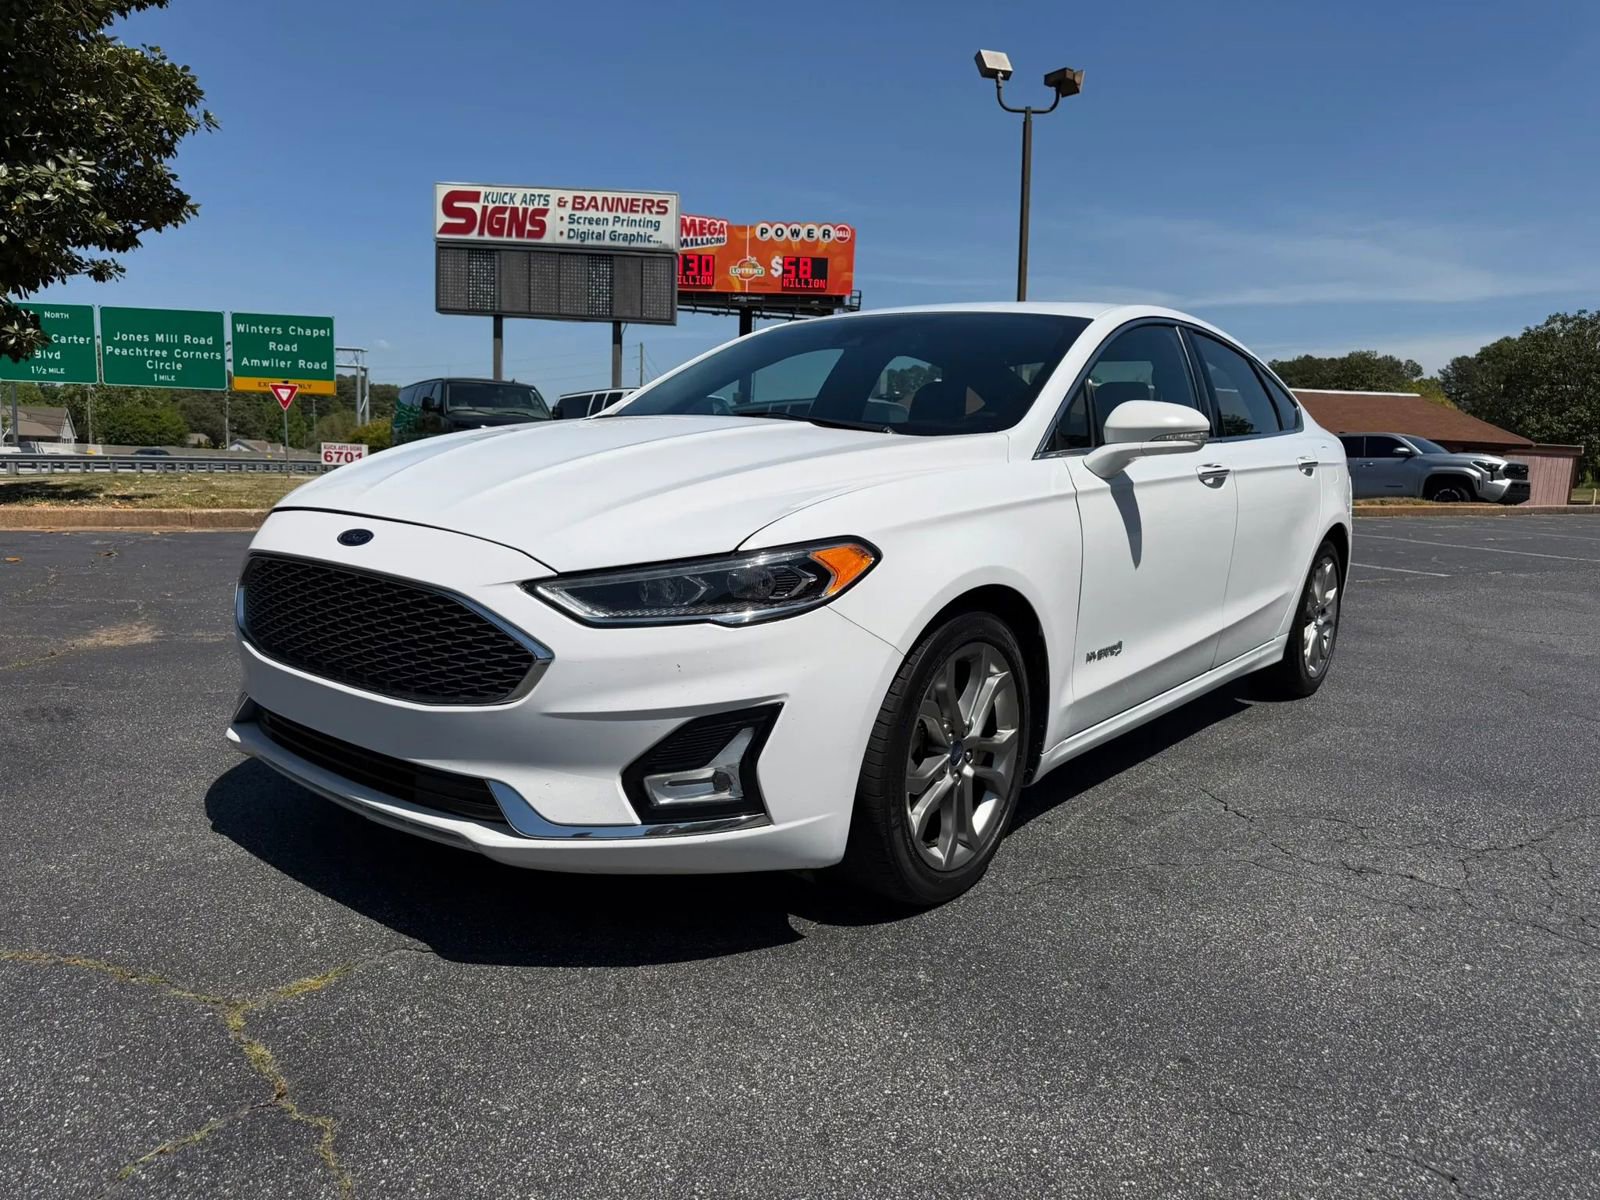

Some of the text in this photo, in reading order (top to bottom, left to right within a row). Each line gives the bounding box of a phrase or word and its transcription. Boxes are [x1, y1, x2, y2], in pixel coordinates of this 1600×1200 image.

[483, 191, 551, 207] KUICK ARTS
[557, 195, 670, 215] & BANNERS
[437, 190, 551, 240] SIGNS
[567, 213, 661, 231] Screen Printing
[680, 217, 726, 237] MEGA
[567, 228, 606, 244] Digital
[678, 275, 713, 286] ILLION
[113, 330, 213, 346] Jones Mill Road
[236, 323, 331, 339] Winters Chapel
[51, 333, 91, 344] Carter
[106, 345, 222, 360] Peachtree Corners
[269, 341, 298, 353] Road
[34, 349, 61, 360] Blvd
[48, 367, 65, 375] MILE
[146, 360, 183, 371] Circle
[241, 357, 328, 371] Amwiler Road
[153, 373, 176, 383] 1 MILE
[323, 450, 363, 464] 6701
